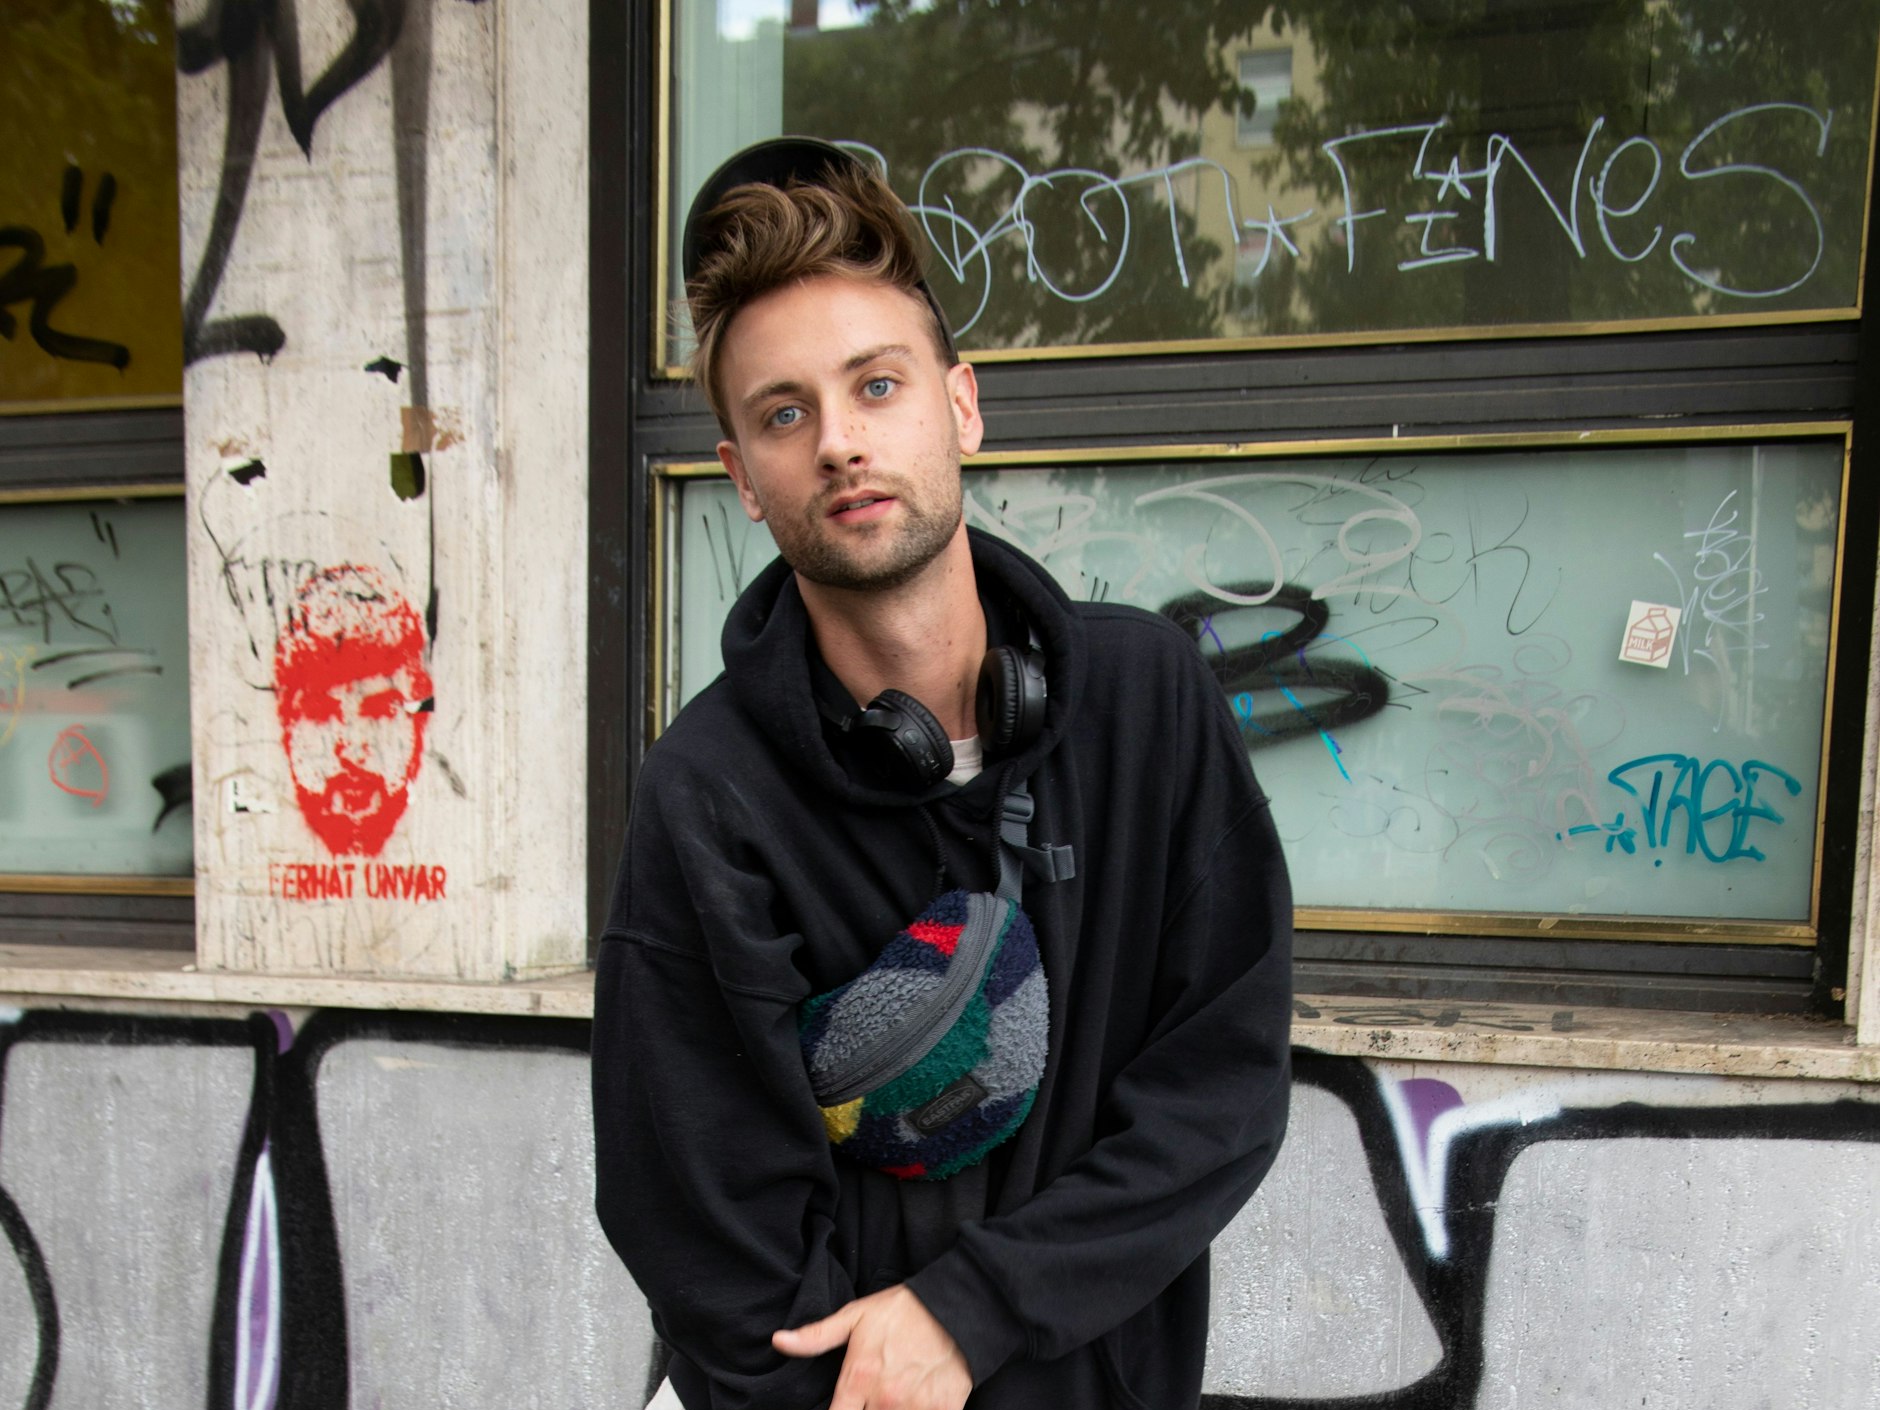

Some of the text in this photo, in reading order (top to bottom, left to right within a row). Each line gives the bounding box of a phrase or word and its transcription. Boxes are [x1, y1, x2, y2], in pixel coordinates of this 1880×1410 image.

[1628, 636, 1654, 652] MILK
[268, 863, 447, 904] FERHAT UNVAR
[922, 1089, 971, 1126] EASTPAK
